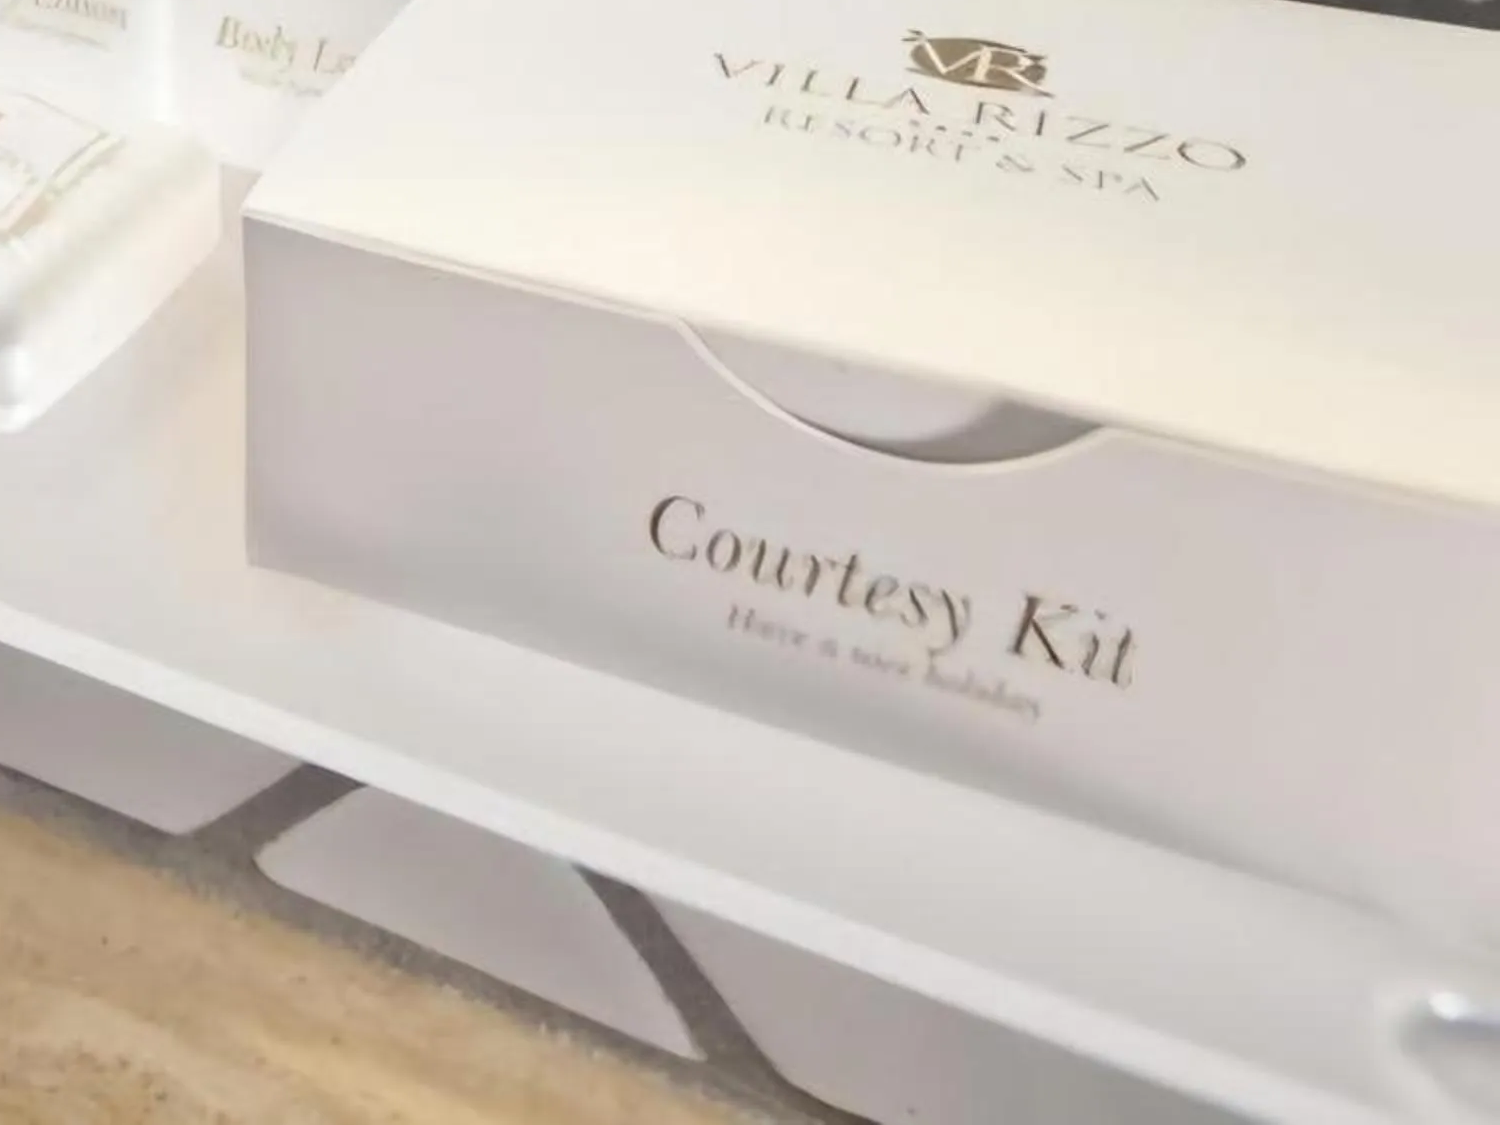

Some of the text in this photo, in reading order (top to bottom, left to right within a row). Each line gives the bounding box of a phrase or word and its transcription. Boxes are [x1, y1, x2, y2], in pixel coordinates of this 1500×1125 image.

[215, 14, 297, 73] Body
[713, 51, 1247, 171] VILLA RIZZO
[763, 104, 1160, 202] RESORT & SPA
[648, 494, 1136, 691] Courtesy Kit
